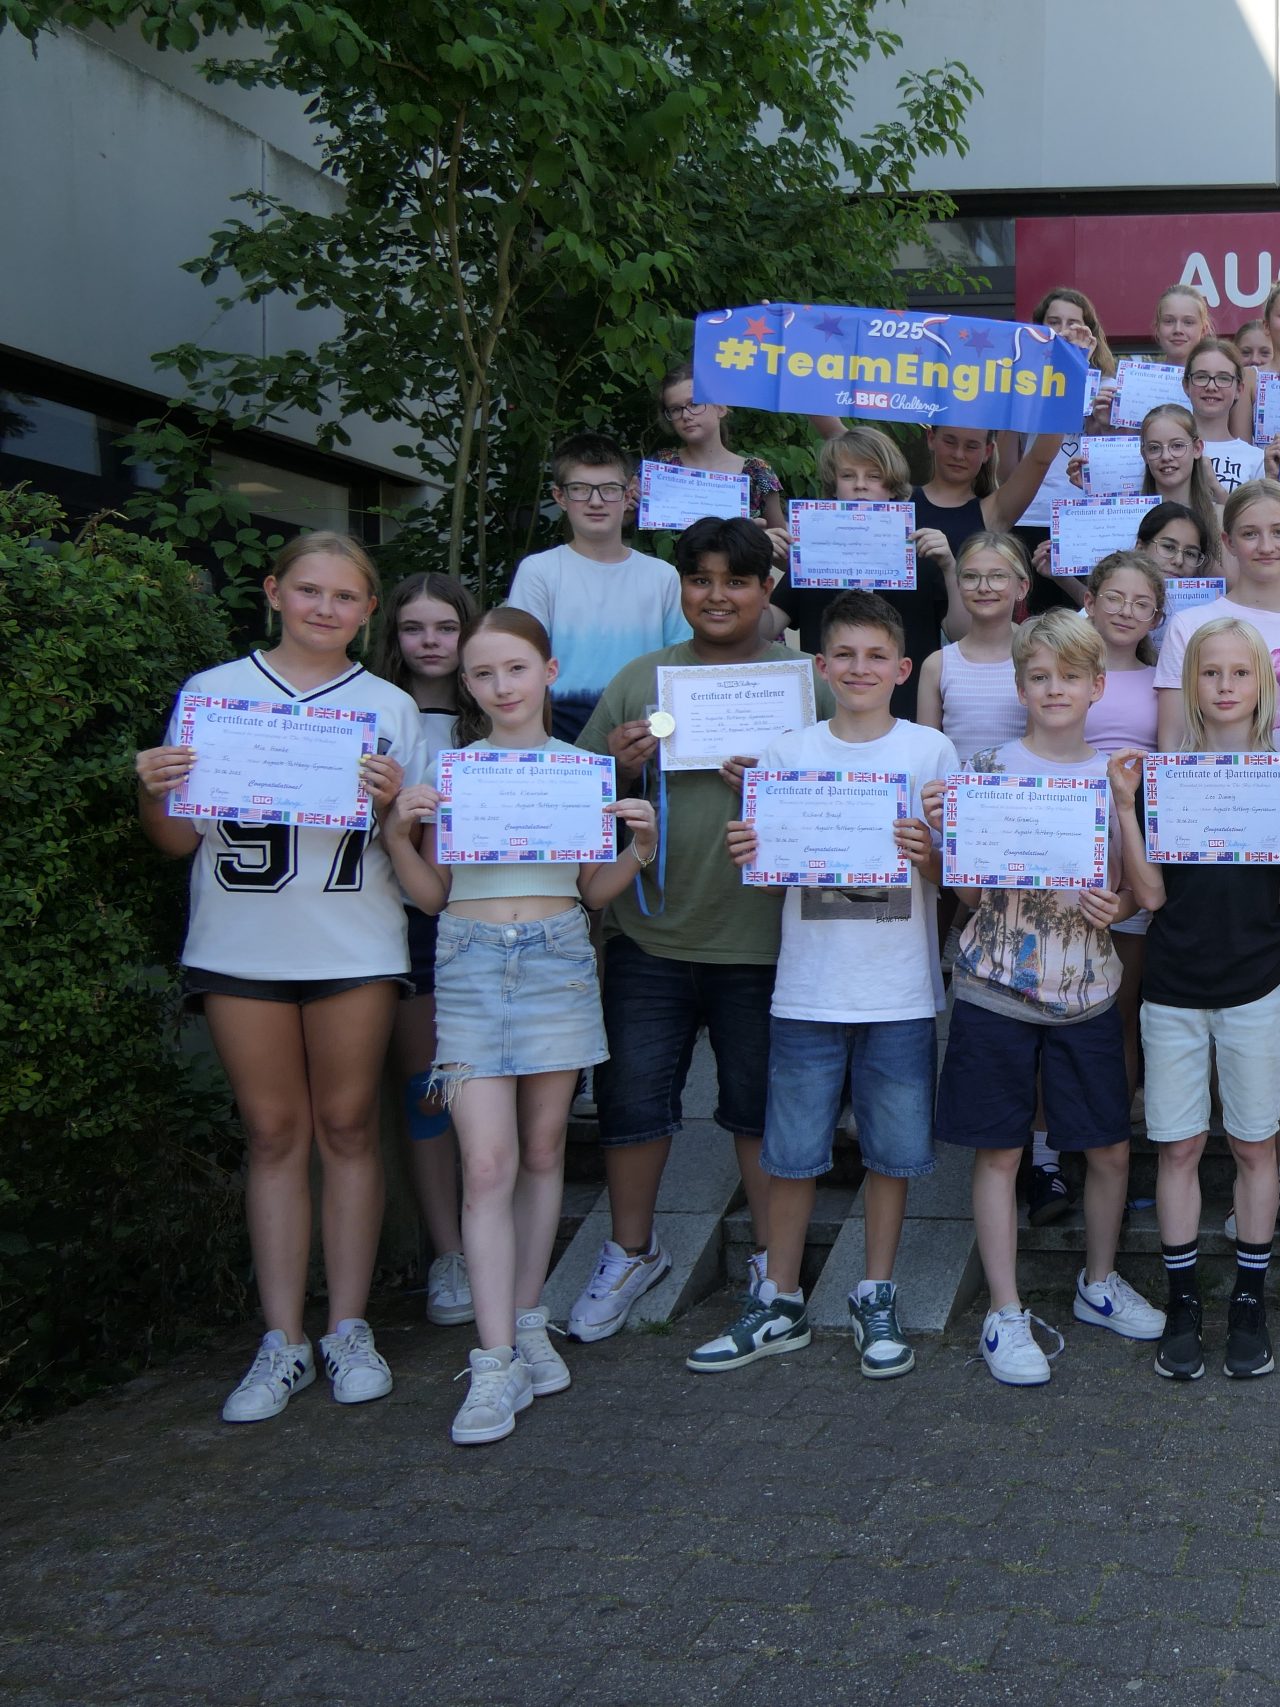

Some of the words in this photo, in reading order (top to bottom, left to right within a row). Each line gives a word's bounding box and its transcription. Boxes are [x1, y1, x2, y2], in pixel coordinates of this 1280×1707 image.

[868, 319, 924, 340] 2025
[715, 338, 1066, 401] #TeamEnglish
[835, 390, 856, 406] the
[856, 391, 889, 407] BIG
[889, 393, 948, 416] Challenge
[691, 692, 732, 701] Certificate
[735, 691, 742, 699] of
[745, 690, 785, 699] Excellence
[207, 713, 264, 728] Certificate
[267, 718, 279, 729] of
[281, 718, 353, 736] Participation
[462, 765, 512, 776] Certificate
[516, 765, 525, 775] of
[529, 766, 593, 777] Participation
[1165, 769, 1211, 779] Certificate
[1213, 769, 1222, 778] of
[248, 779, 303, 790] Congratulations!
[765, 786, 812, 795] Certificate
[815, 786, 824, 795] of
[828, 786, 888, 797] Participation
[966, 789, 1013, 800] Certificate
[1016, 790, 1025, 800] of
[1028, 791, 1088, 803] Participation
[504, 823, 553, 832] Congratulations!
[1203, 826, 1247, 834] Congratulations!
[803, 845, 850, 853] Congratulations!
[1003, 849, 1048, 857] Congratulations!
